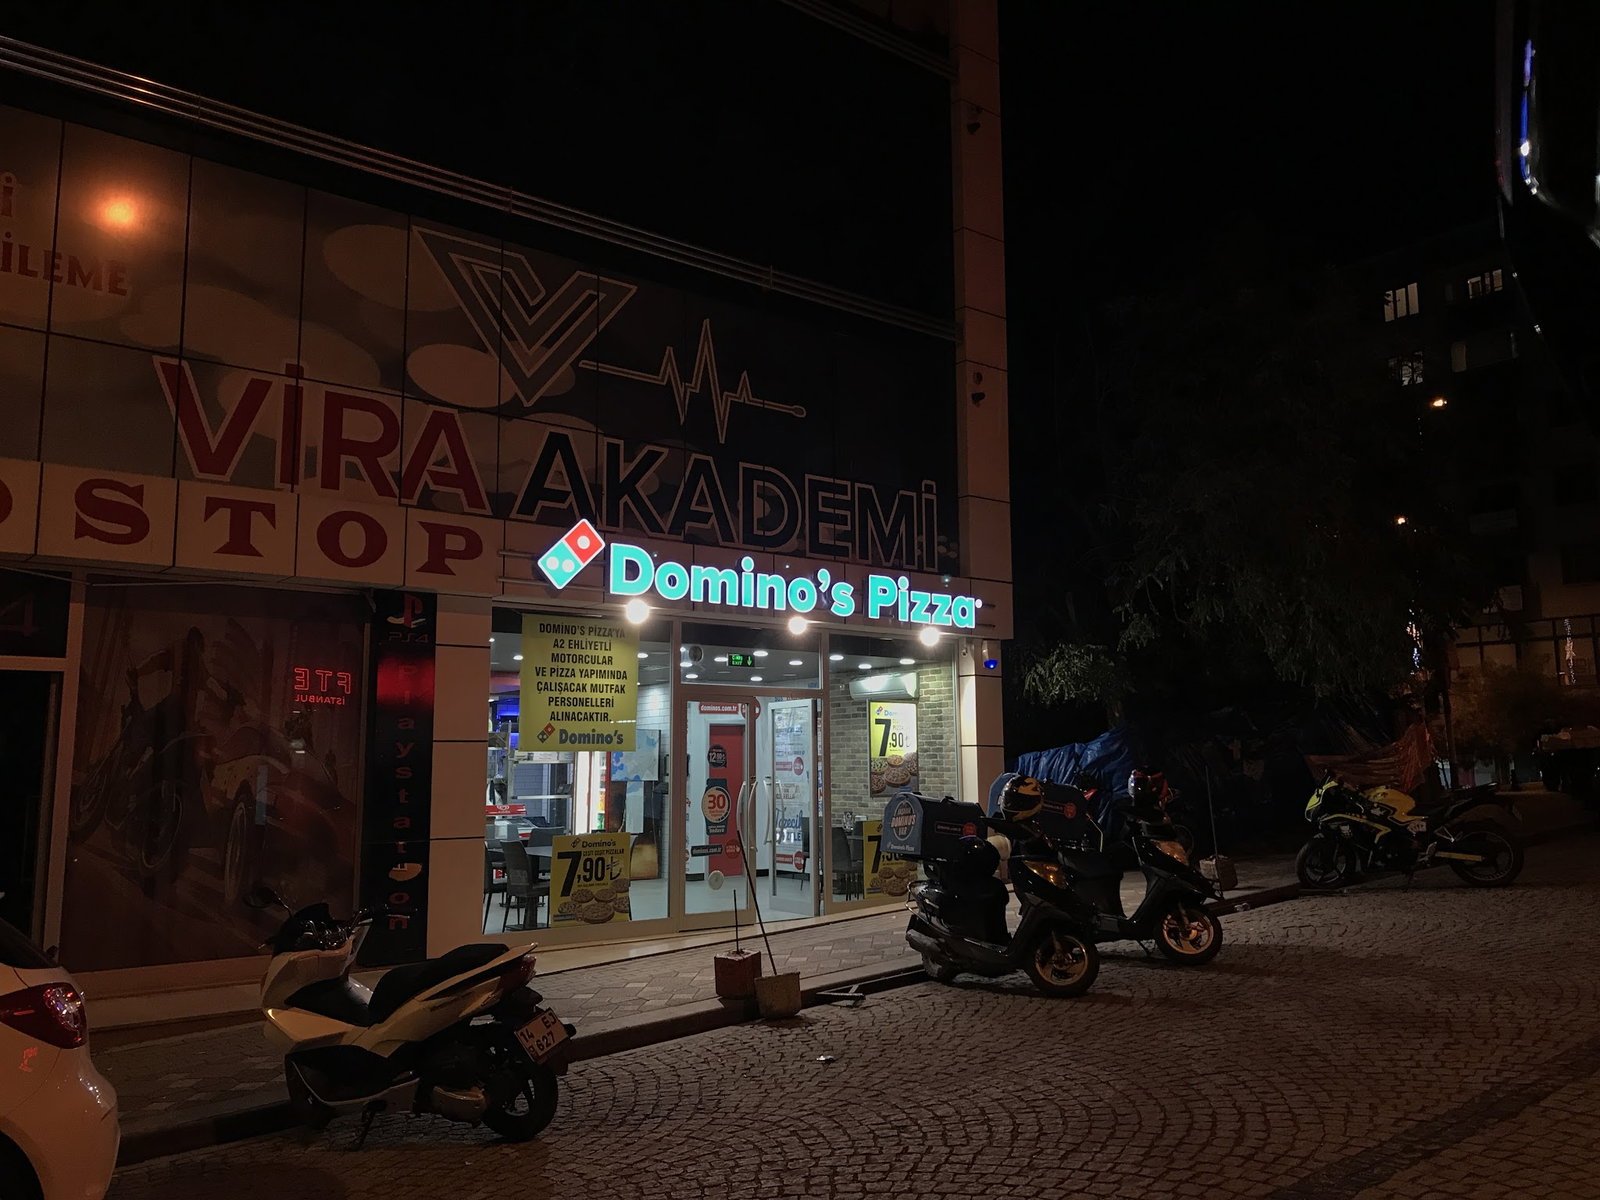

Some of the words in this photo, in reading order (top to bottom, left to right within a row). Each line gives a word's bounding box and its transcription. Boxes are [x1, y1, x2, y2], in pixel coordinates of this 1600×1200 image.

[152, 355, 492, 515] VİRA
[510, 425, 939, 573] AKADEMİ
[609, 543, 856, 617] Domino's
[867, 574, 977, 629] Pizza
[388, 631, 430, 644] PS4
[539, 622, 585, 636] DOMİNO'S
[588, 625, 625, 639] PİZZA'YA
[553, 639, 565, 649] A2
[568, 639, 612, 652] EHLİYETLİ
[551, 652, 613, 665] MOTORCULAR
[535, 666, 547, 677] VE
[549, 666, 576, 678] PİZZA
[578, 668, 628, 680] YAPIMINDA
[536, 681, 587, 695] ÇALIŞACAK
[590, 683, 626, 694] MUTFAK
[548, 696, 614, 708] PERSONELLERİ
[550, 711, 612, 722] ALINACAKTIR.
[558, 728, 624, 745] Domino's
[707, 794, 726, 810] 30
[581, 838, 617, 848] Domino's
